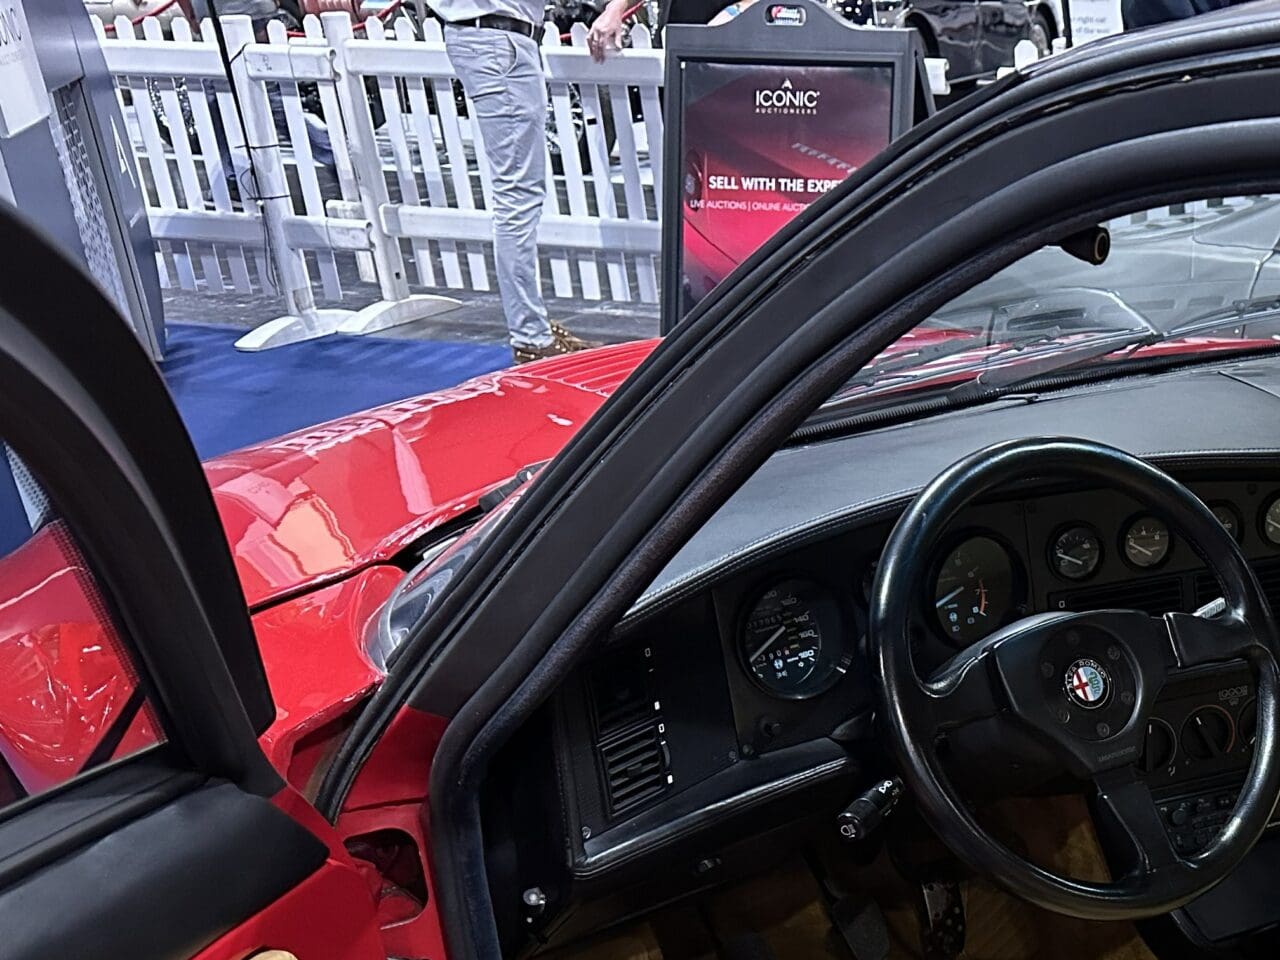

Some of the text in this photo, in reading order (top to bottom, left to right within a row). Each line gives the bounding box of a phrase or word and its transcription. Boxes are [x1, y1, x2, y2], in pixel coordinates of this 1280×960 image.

[755, 89, 818, 107] ICONIC
[755, 107, 817, 115] AUCTIONEERS
[708, 176, 843, 193] SELL WITH THE EXPE
[690, 200, 705, 209] LIVE
[706, 201, 747, 210] AUCTIONS
[752, 201, 780, 211] ONLINE
